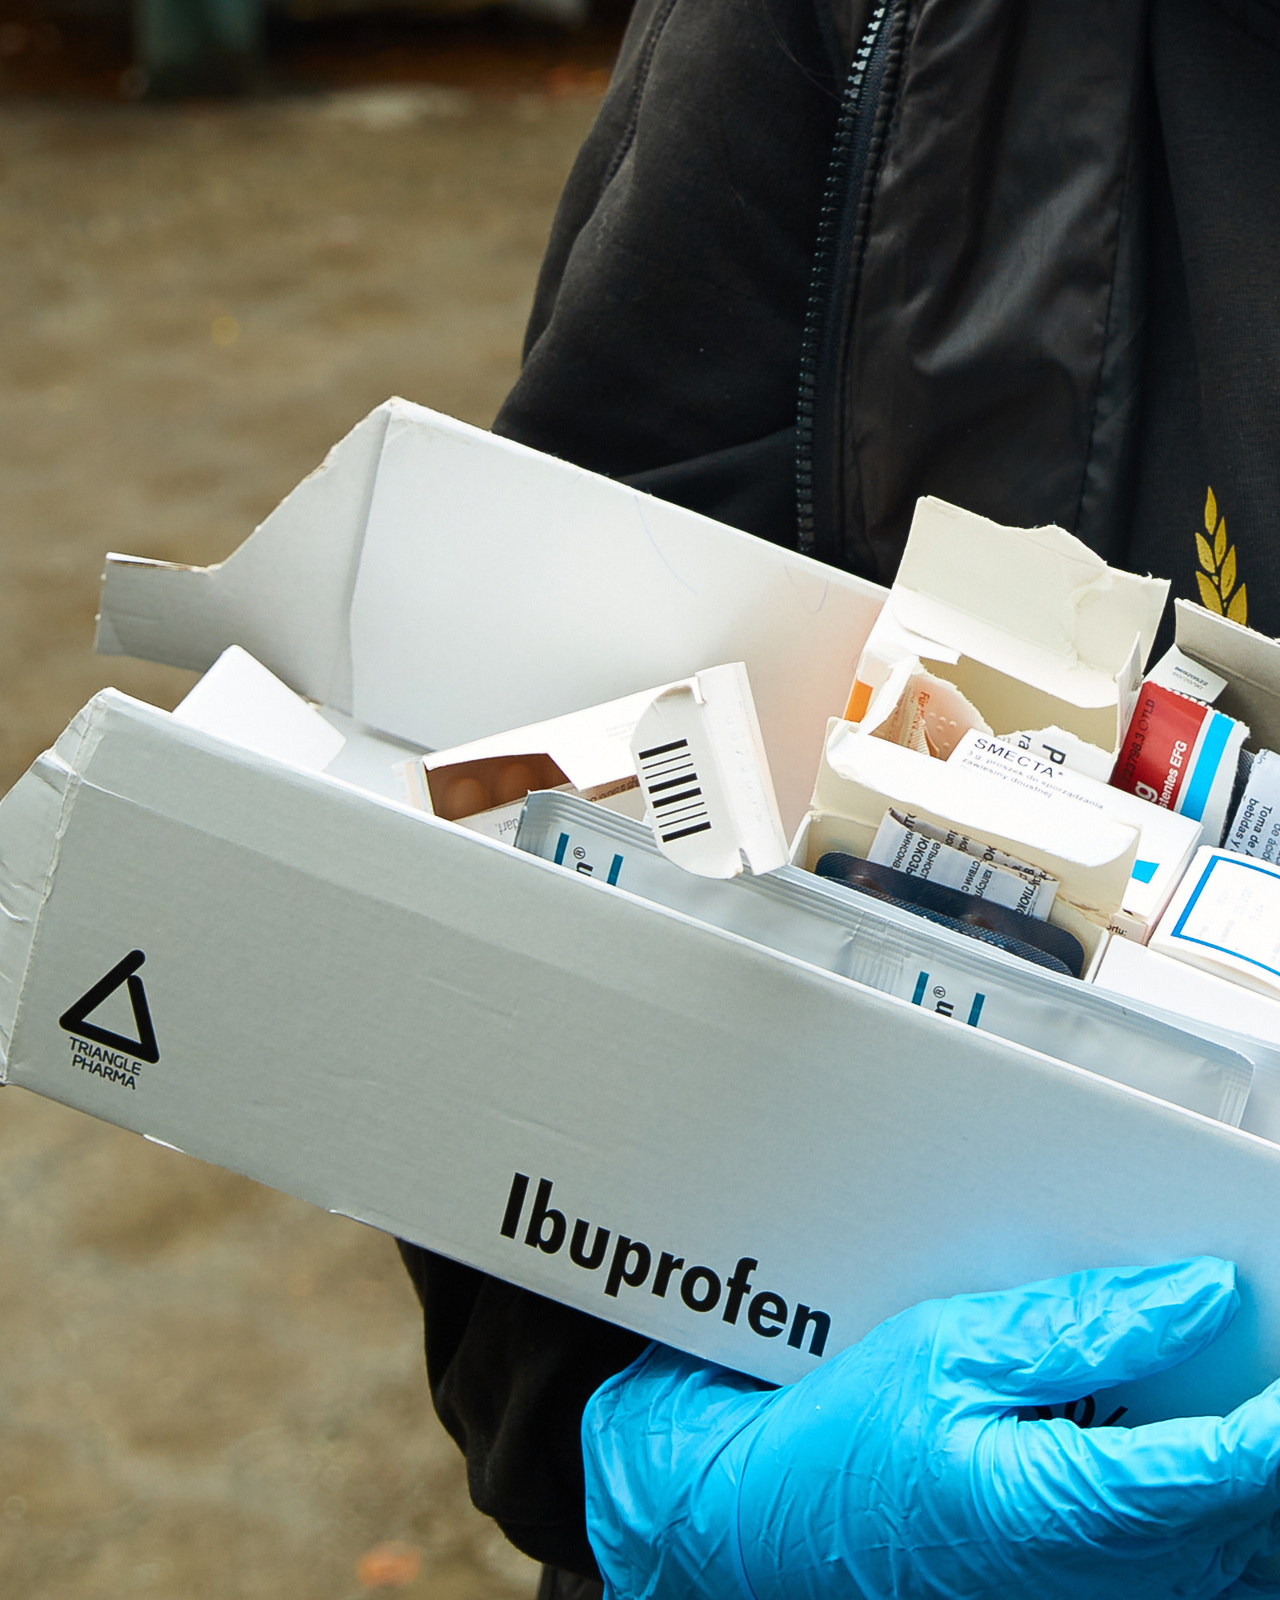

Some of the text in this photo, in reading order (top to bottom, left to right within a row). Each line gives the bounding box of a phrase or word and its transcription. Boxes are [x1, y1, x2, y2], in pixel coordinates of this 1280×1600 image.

[1121, 732, 1146, 782] 723798.3
[1169, 740, 1188, 768] EFG
[961, 756, 1009, 781] zawiesiny
[1009, 776, 1053, 799] doustnej
[985, 757, 1024, 777] proszek
[1025, 773, 1039, 783] do
[1039, 779, 1104, 810] sporządzania
[1228, 797, 1260, 849] bebidas y
[1251, 802, 1274, 834] Toma
[1246, 833, 1261, 850] de
[69, 1036, 142, 1076] TRIANGLE
[72, 1053, 136, 1090] PHARMA
[500, 1172, 831, 1357] Ibuprofen
